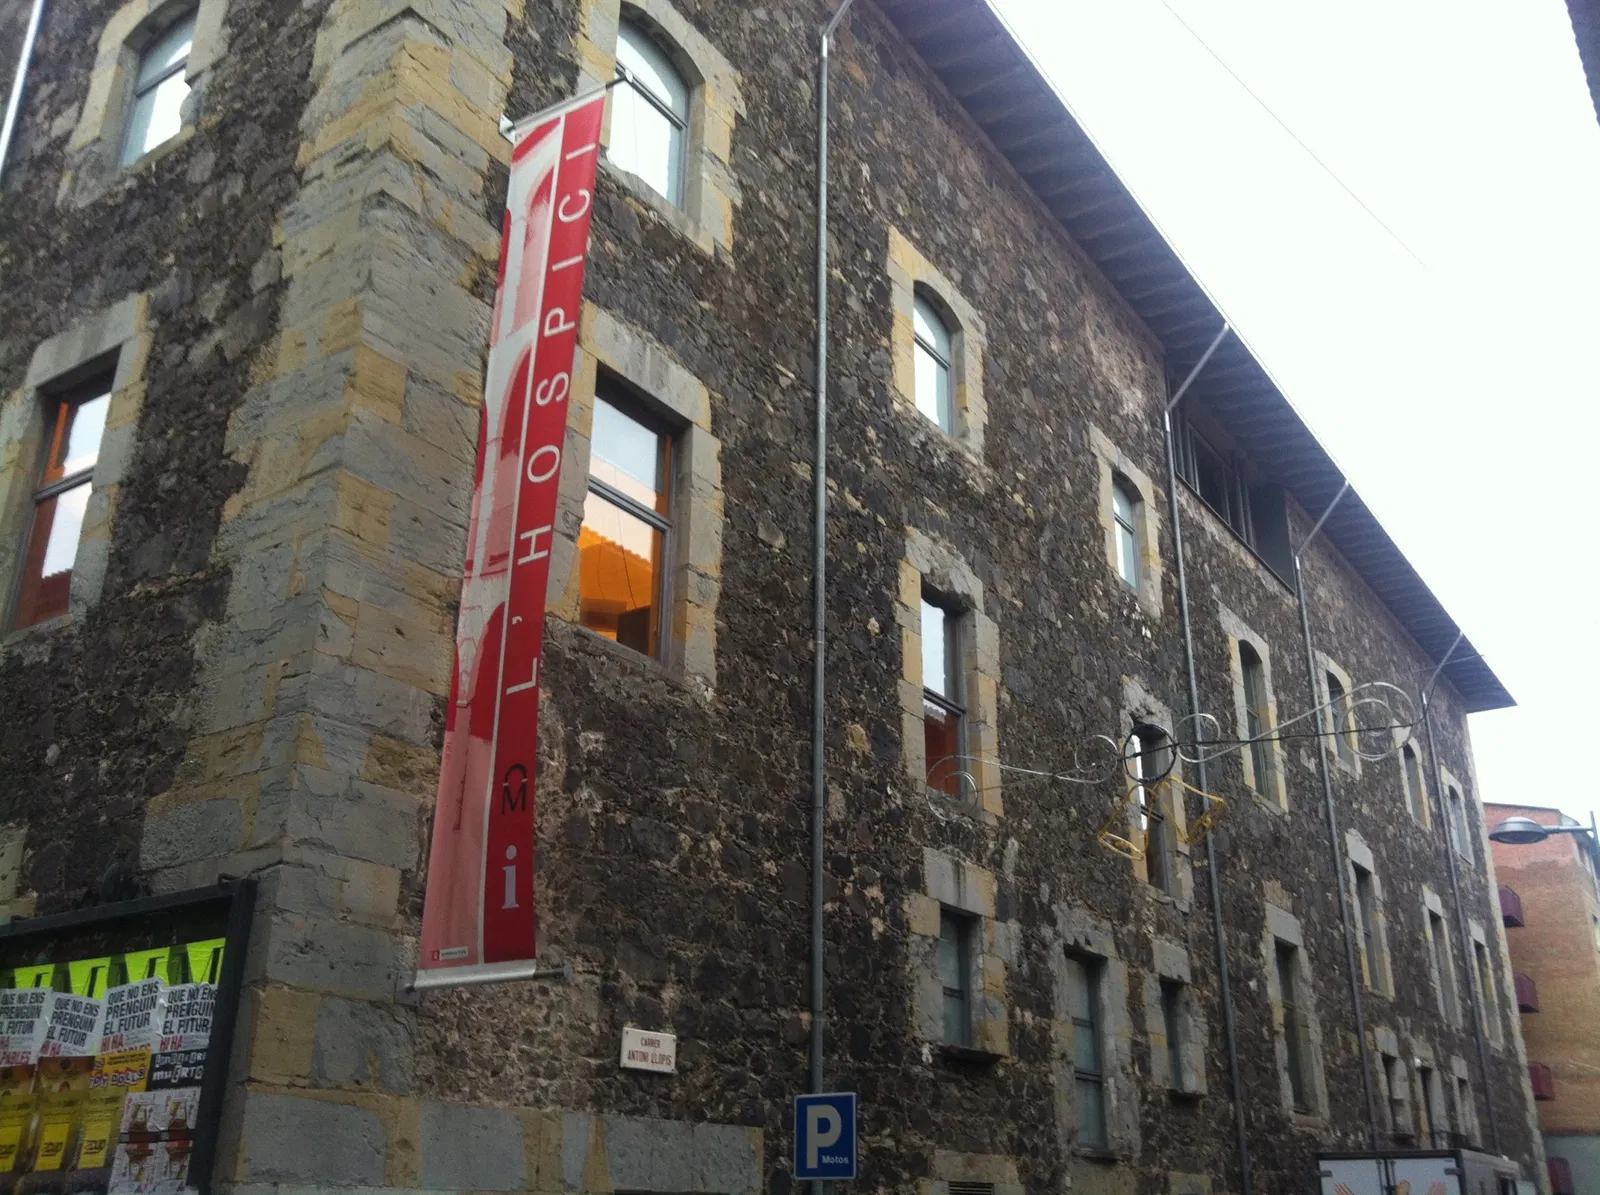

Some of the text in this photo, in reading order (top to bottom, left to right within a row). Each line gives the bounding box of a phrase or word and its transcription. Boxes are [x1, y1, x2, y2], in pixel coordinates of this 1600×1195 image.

[506, 142, 597, 696] L'HOSPICI
[108, 981, 159, 1005] QUE NO ENS
[168, 989, 186, 1004] QUE
[187, 987, 199, 1001] NO
[55, 998, 100, 1017] QUE NO ENS
[105, 995, 158, 1021] PRENGUIN
[50, 1010, 96, 1032] PRENGUIN
[103, 1012, 150, 1036] EL FUTUR
[163, 1017, 210, 1035] EL FUTUR
[46, 1025, 56, 1040] EL
[58, 1027, 87, 1048] FUTUR
[170, 1034, 183, 1050] HA
[627, 1049, 672, 1066] ANTONI LLOPIS
[806, 1104, 842, 1169] P
[822, 1155, 849, 1165] Motos
